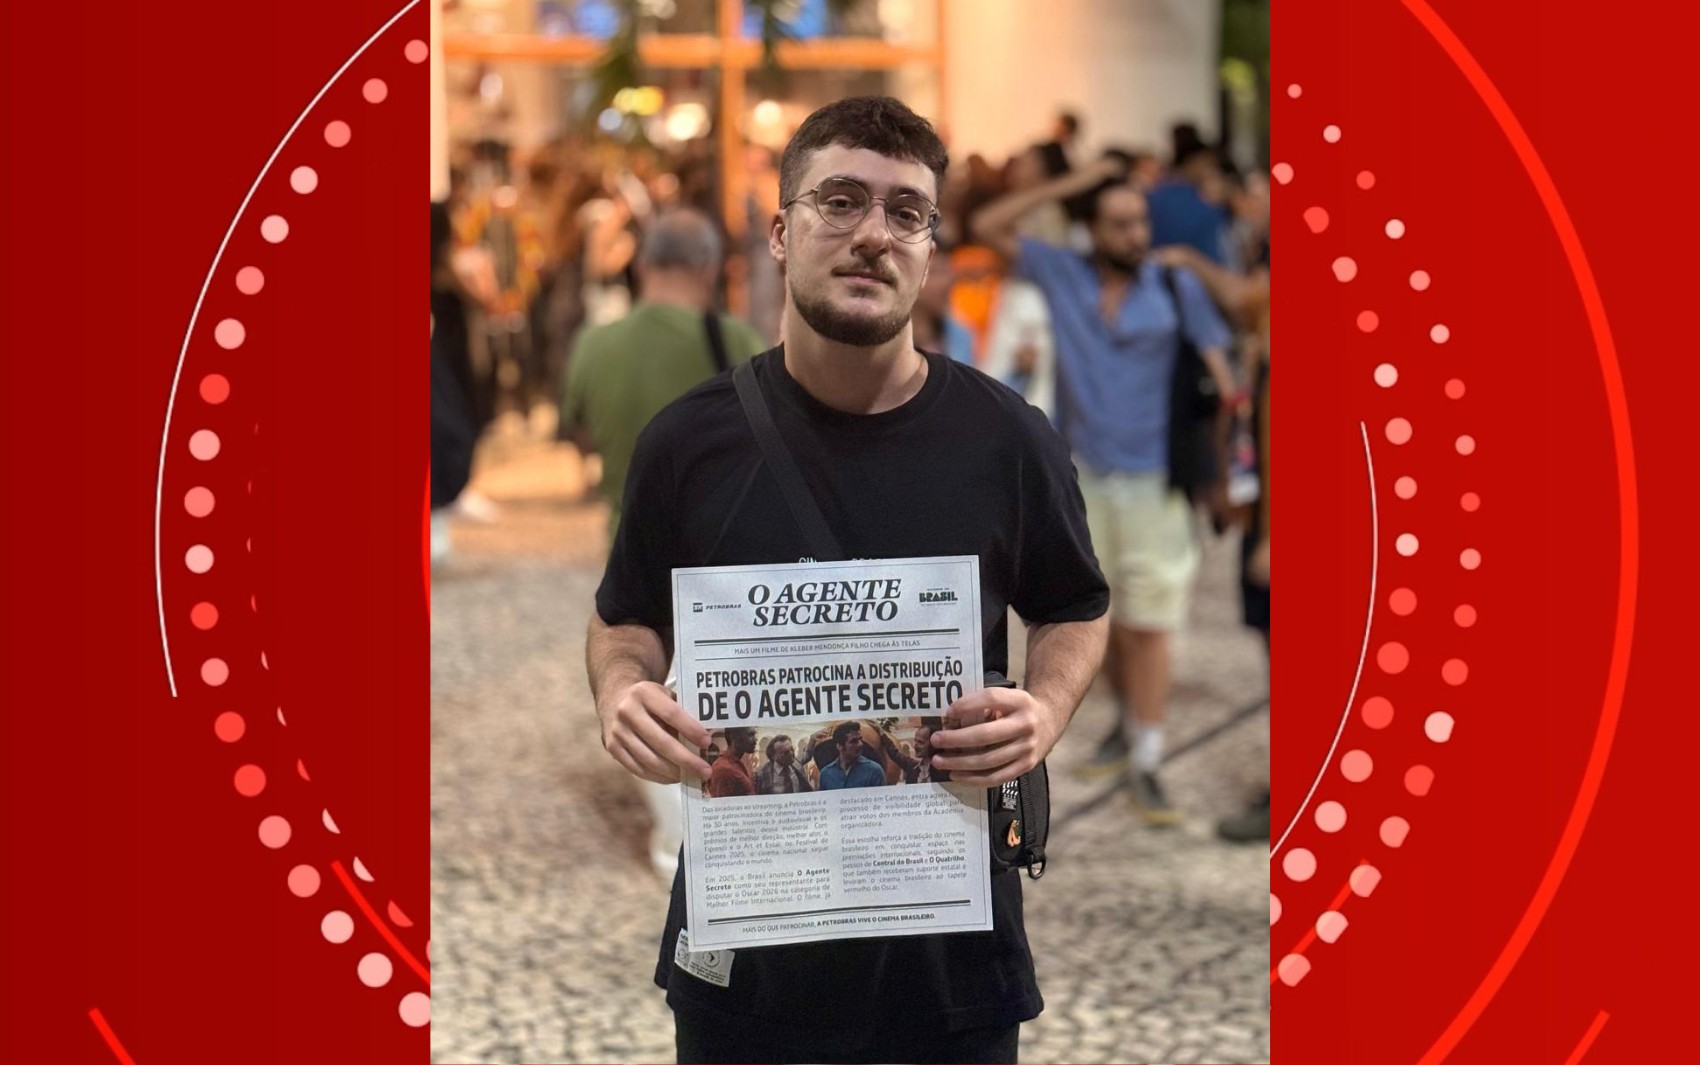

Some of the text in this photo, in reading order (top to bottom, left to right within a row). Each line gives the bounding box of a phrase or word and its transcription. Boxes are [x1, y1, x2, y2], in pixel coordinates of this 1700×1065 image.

[747, 577, 902, 605] O AGENTE
[918, 591, 958, 602] BRASIL
[751, 600, 898, 627] SECRETO
[814, 643, 849, 651] MENDONÇA
[695, 655, 963, 688] PETROBRAS PATROCINA A DISTRIBUIÇÃO
[697, 678, 963, 721] DE O AGENTE SECRETO
[839, 795, 872, 804] destacado
[839, 805, 868, 813] processo
[858, 811, 876, 819] votos
[878, 810, 890, 818] dos
[891, 808, 921, 817] membros
[872, 858, 895, 866] Central
[905, 856, 923, 864] Brasil
[805, 867, 829, 876] Agente
[705, 882, 731, 891] Secreto
[742, 925, 756, 933] MAIS
[821, 918, 856, 926] PETROBRAS
